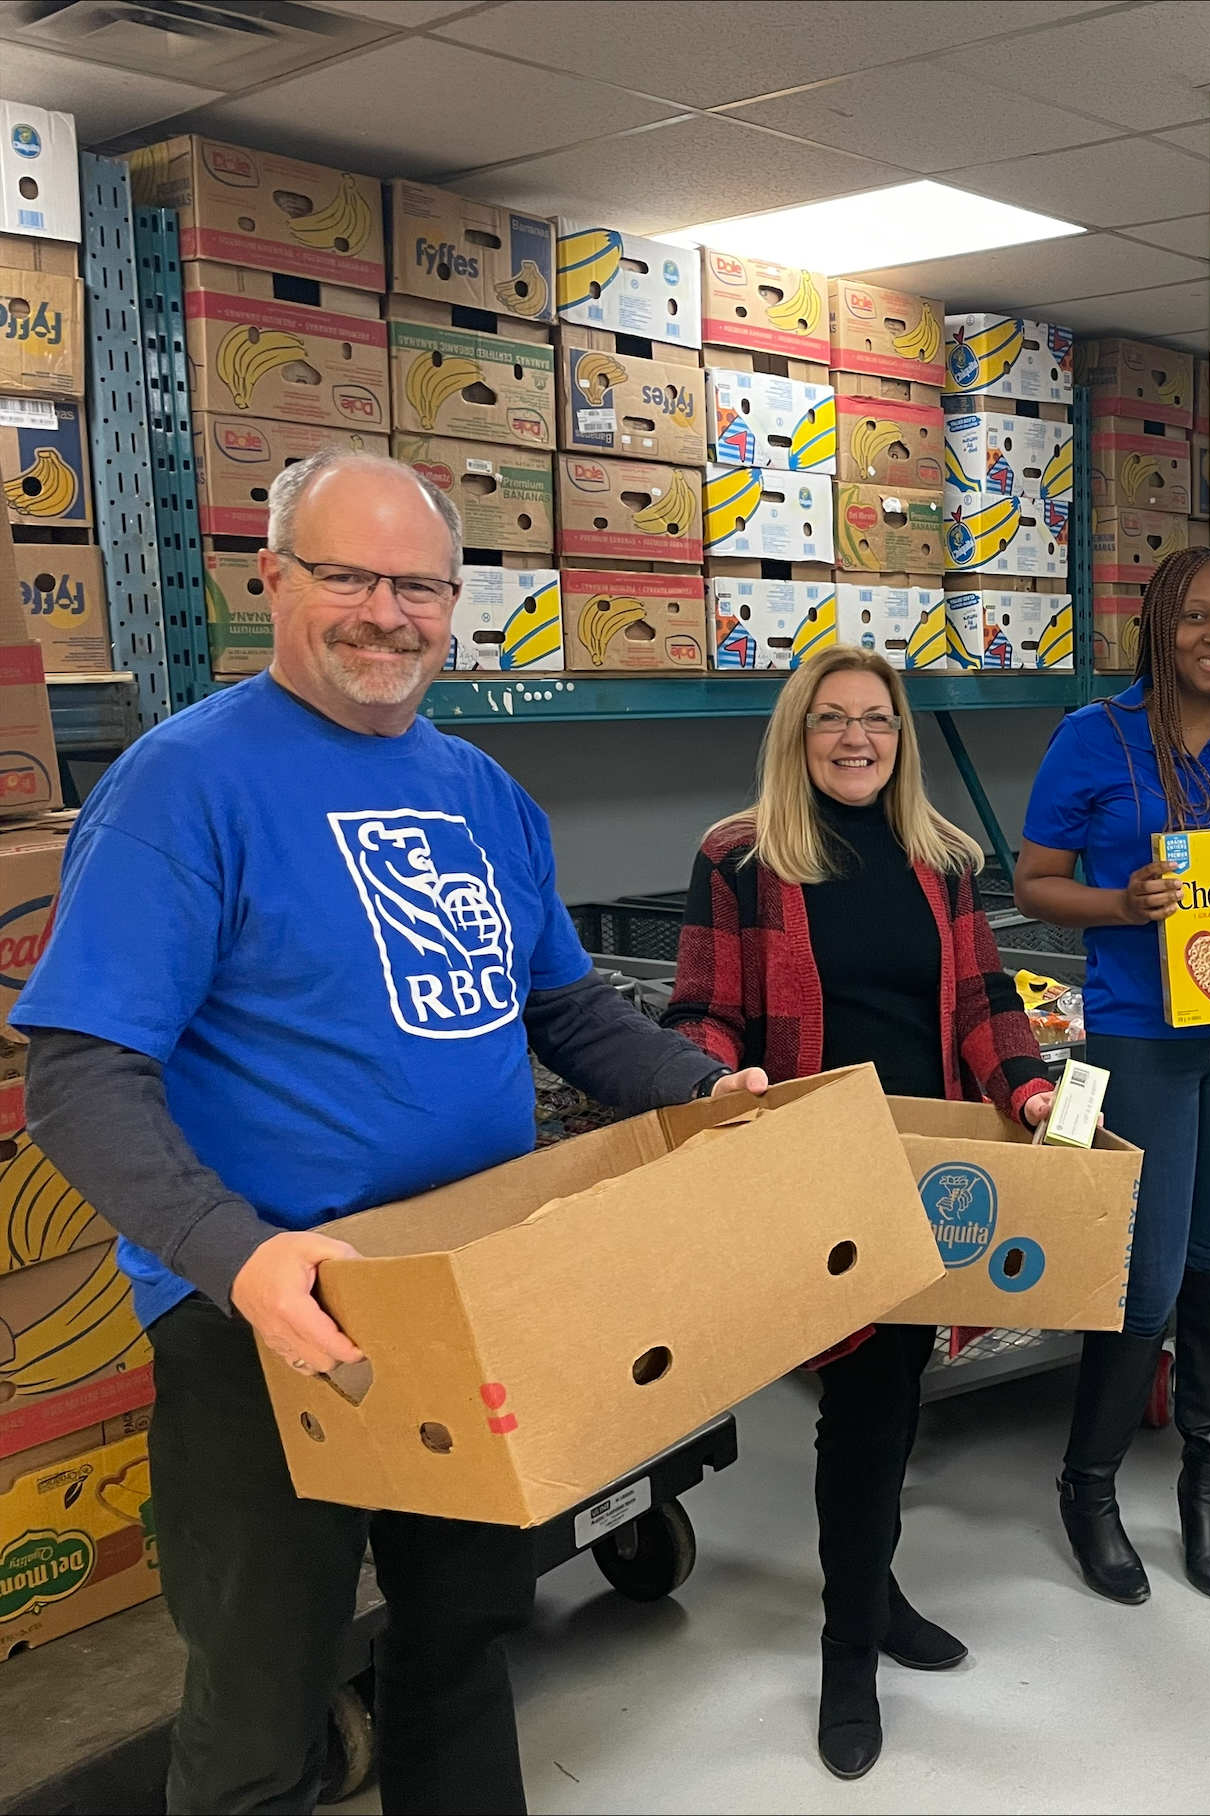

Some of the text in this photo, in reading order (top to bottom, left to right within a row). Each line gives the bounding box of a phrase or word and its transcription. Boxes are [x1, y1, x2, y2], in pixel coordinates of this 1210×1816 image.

[511, 219, 550, 238] Bananas
[716, 257, 743, 275] Dole
[850, 295, 873, 311] Dole
[398, 335, 550, 370] BANANAS CERTIFIED ORGANIC BANANAS
[340, 399, 374, 417] Dole
[513, 421, 541, 436] Dole
[224, 428, 262, 449] Dole
[574, 464, 604, 480] Dole
[503, 478, 544, 490] Premium
[503, 491, 551, 503] BANANAS
[229, 611, 272, 623] ANANA
[229, 625, 274, 636] emium
[671, 647, 696, 660] Dole
[405, 966, 508, 1022] RBC
[930, 1221, 989, 1249] hiquita
[8, 1546, 54, 1570] Quality
[0, 1549, 85, 1596] Del Mon
